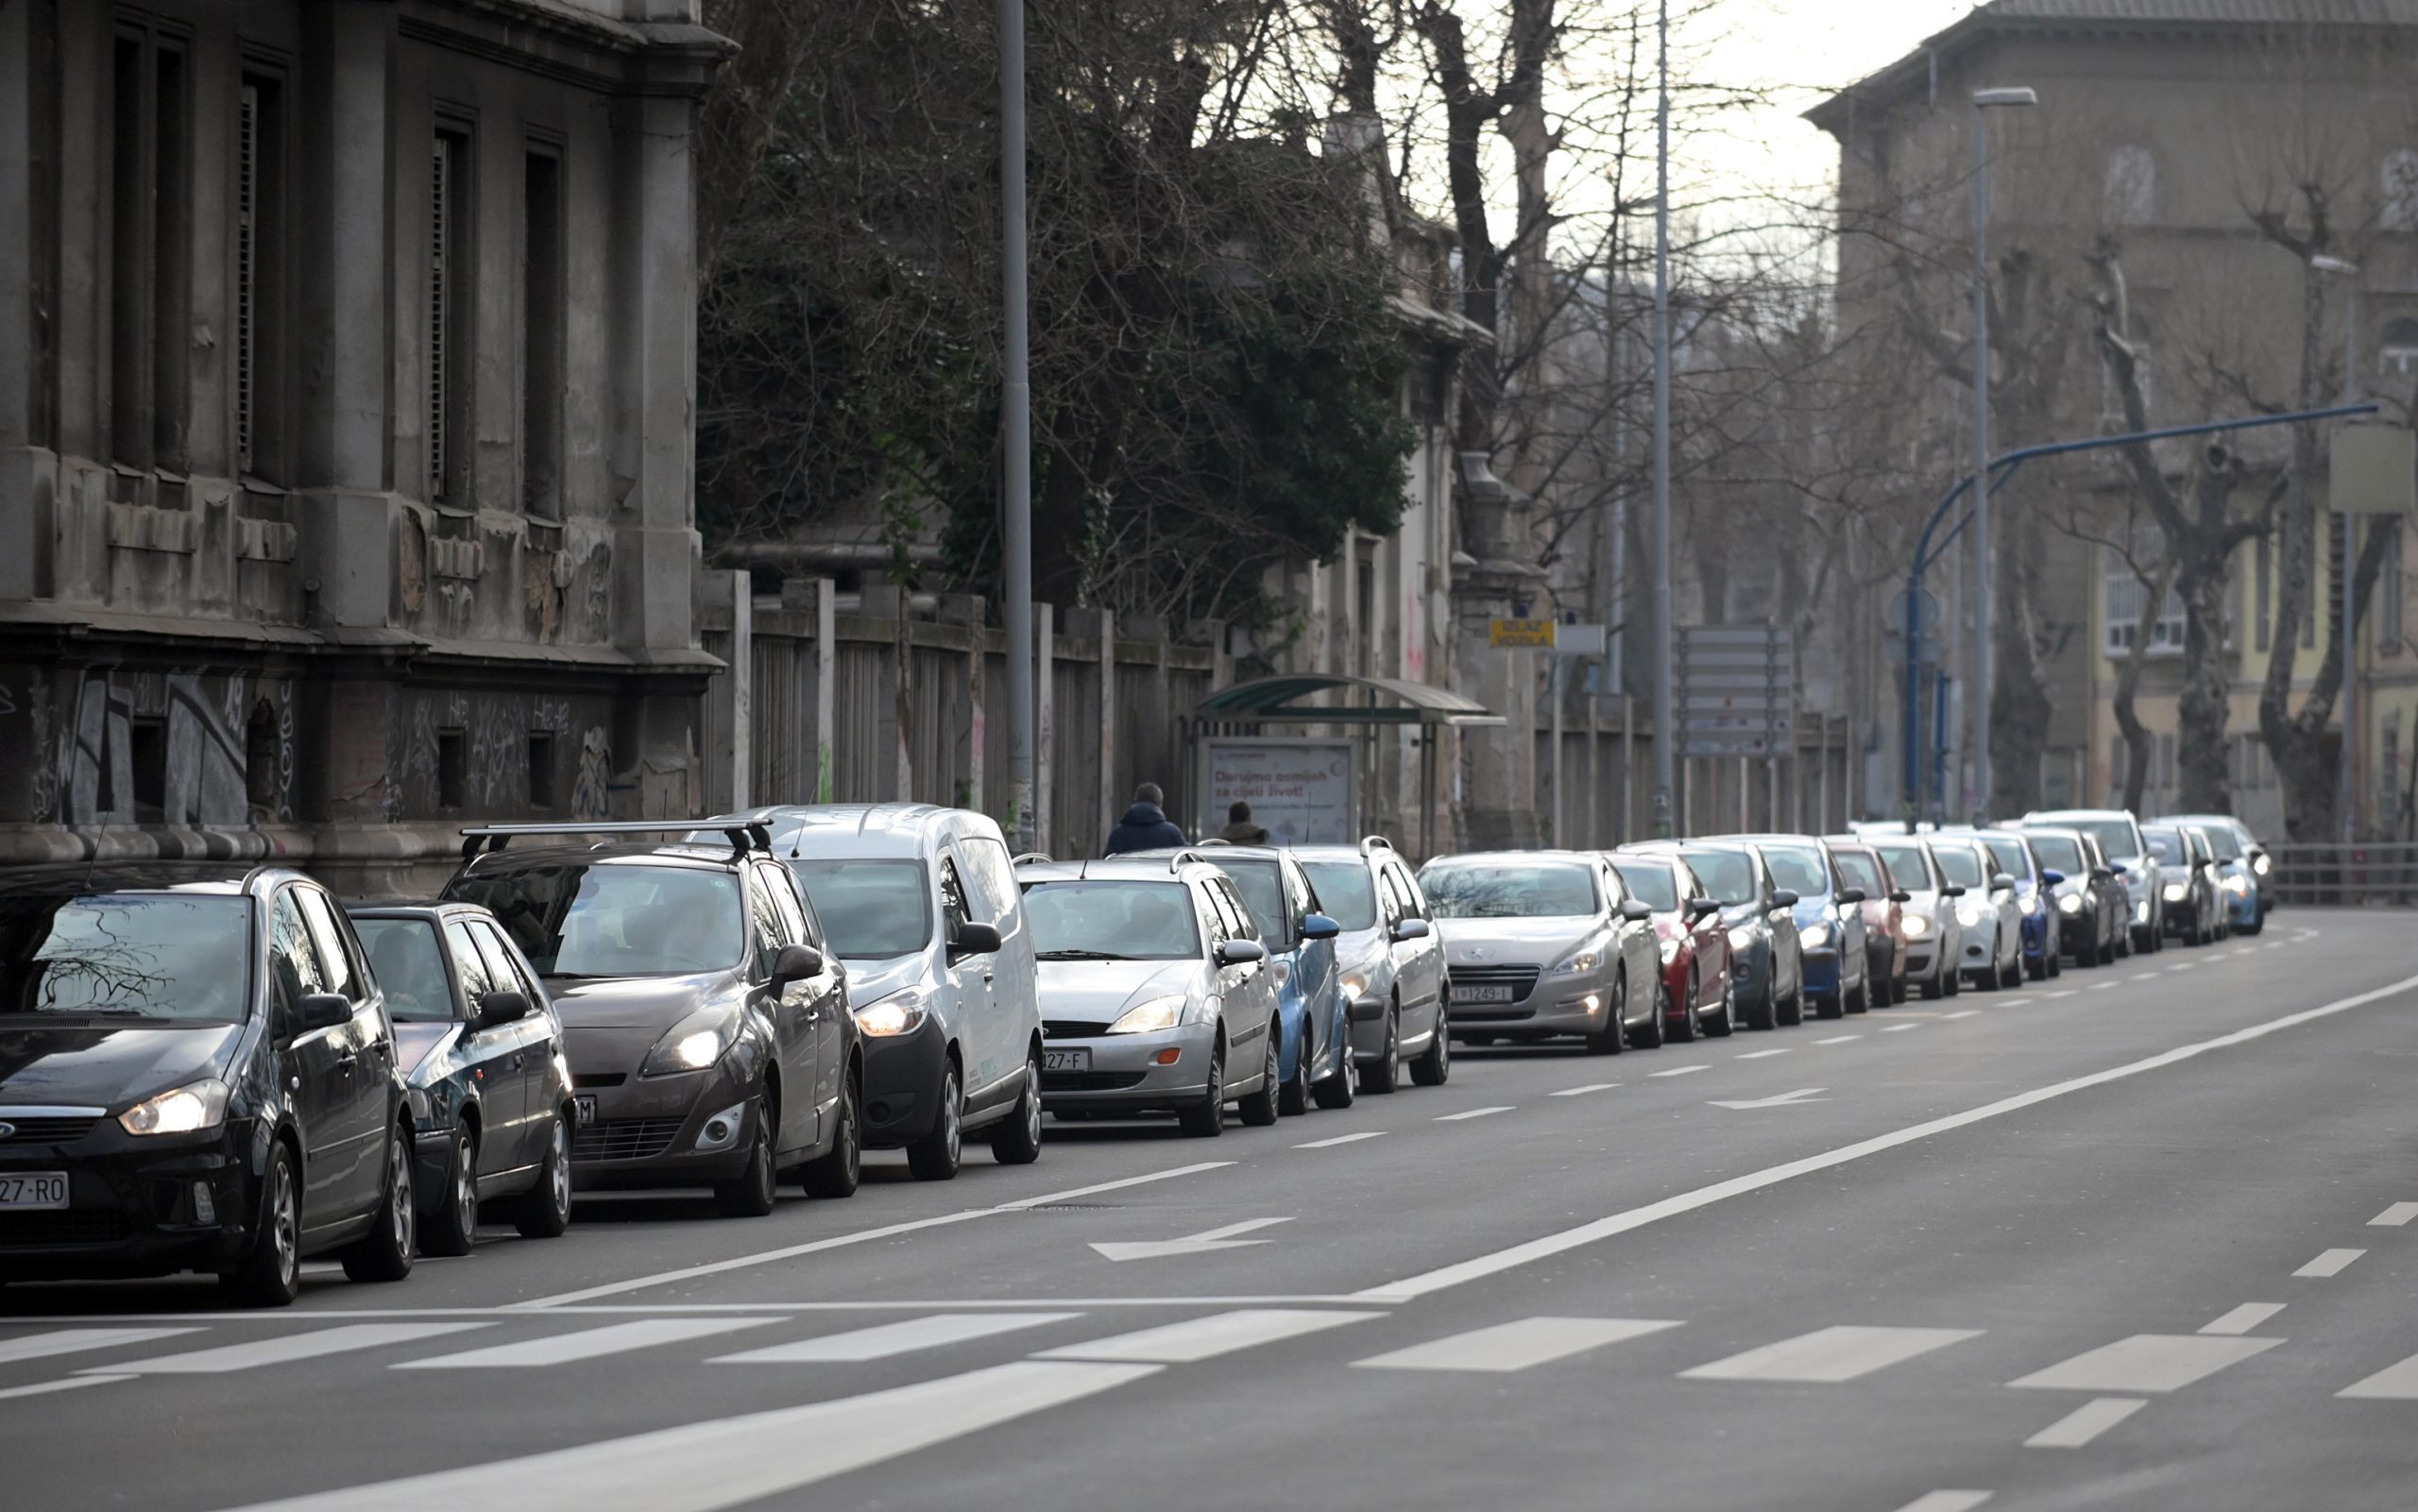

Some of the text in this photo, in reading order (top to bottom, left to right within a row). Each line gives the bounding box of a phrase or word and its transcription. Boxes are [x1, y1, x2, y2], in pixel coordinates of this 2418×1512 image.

[1216, 771, 1327, 784] Darujmo osmijeh
[1216, 789, 1230, 797] za
[1233, 786, 1264, 799] cijeli
